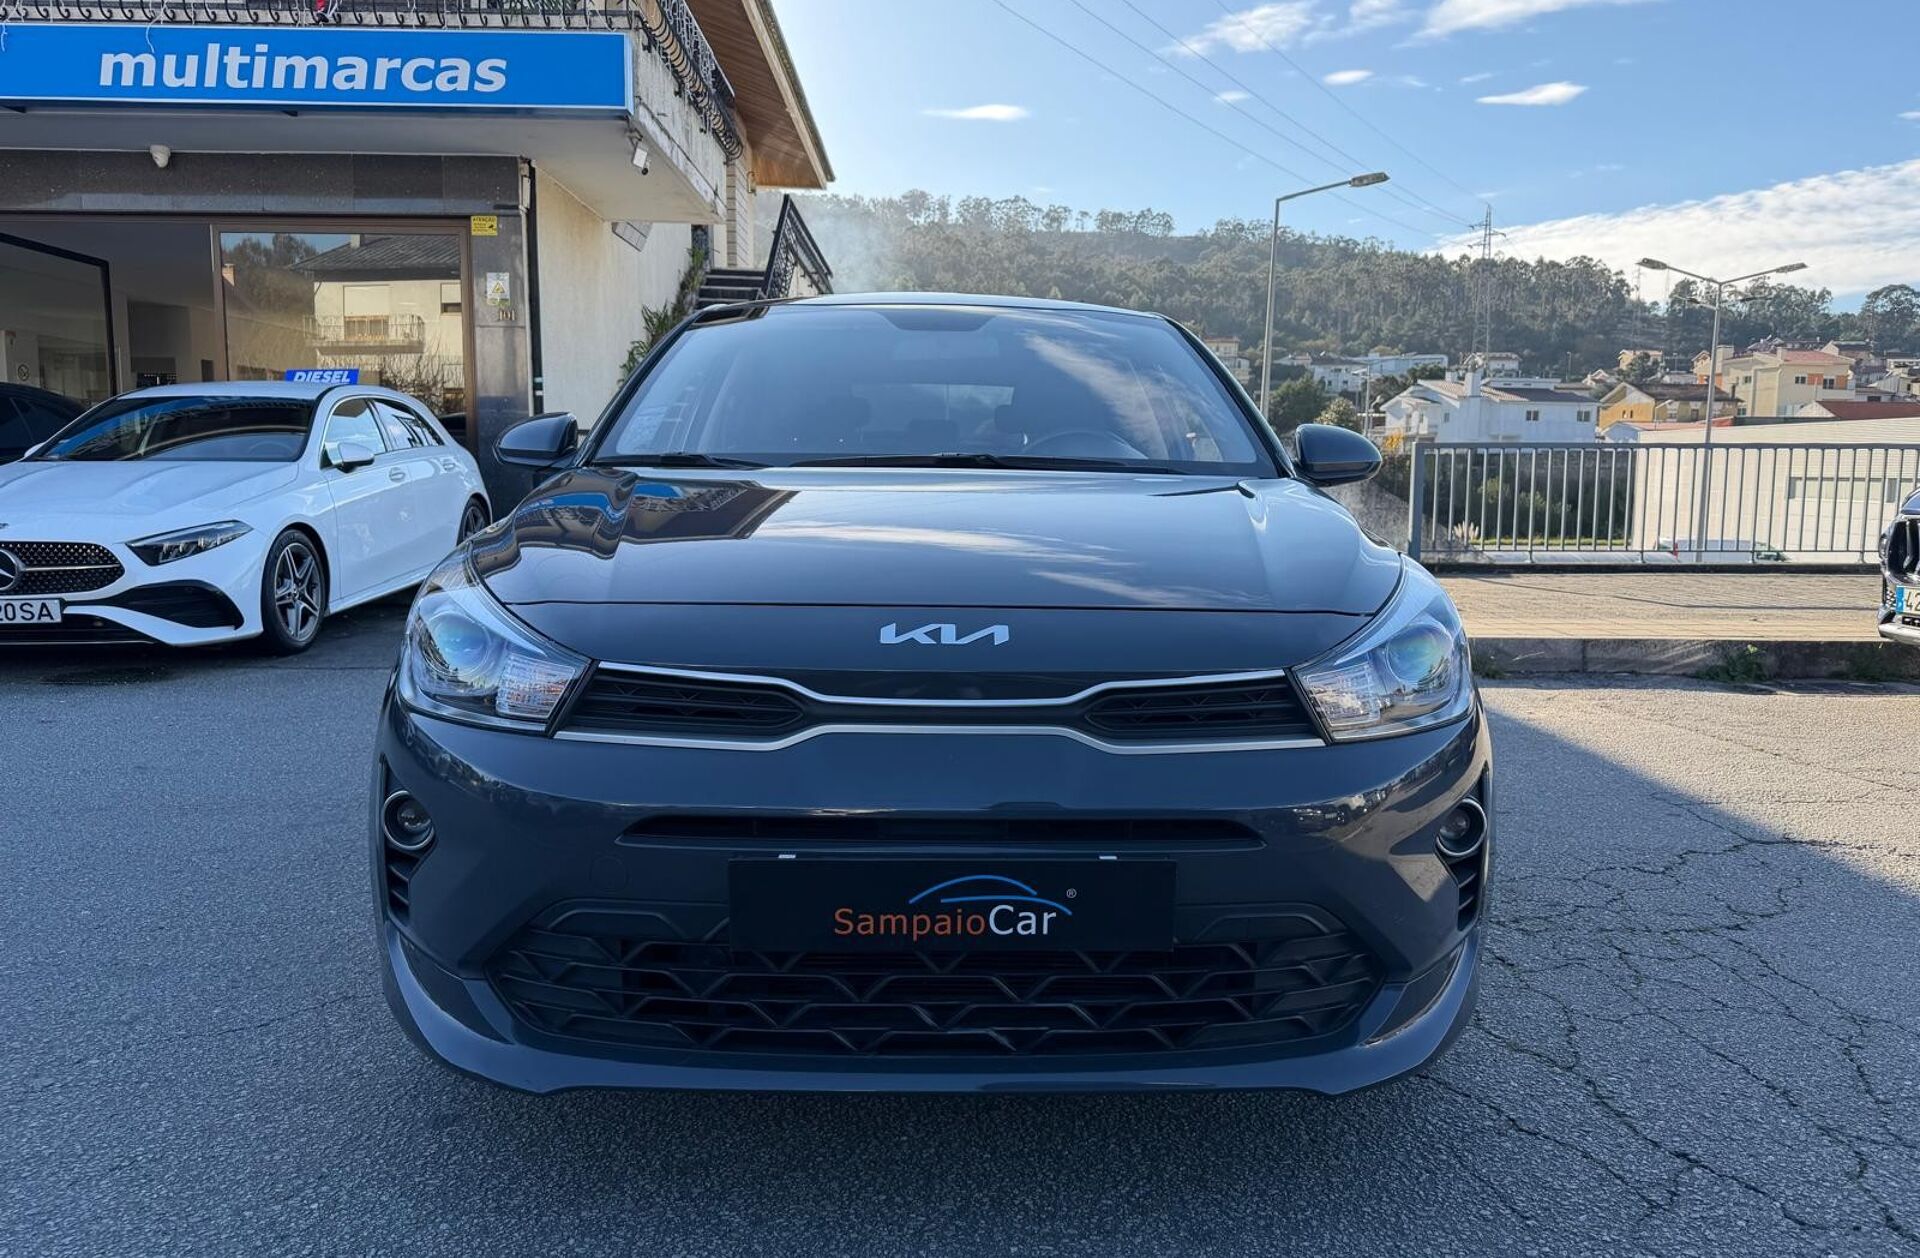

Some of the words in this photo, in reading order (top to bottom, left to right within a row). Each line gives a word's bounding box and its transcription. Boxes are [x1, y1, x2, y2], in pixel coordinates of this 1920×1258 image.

[99, 42, 508, 92] multimarcas
[293, 370, 351, 383] DIESEL
[880, 622, 1010, 646] KIA
[834, 904, 1057, 942] SampaioCar
